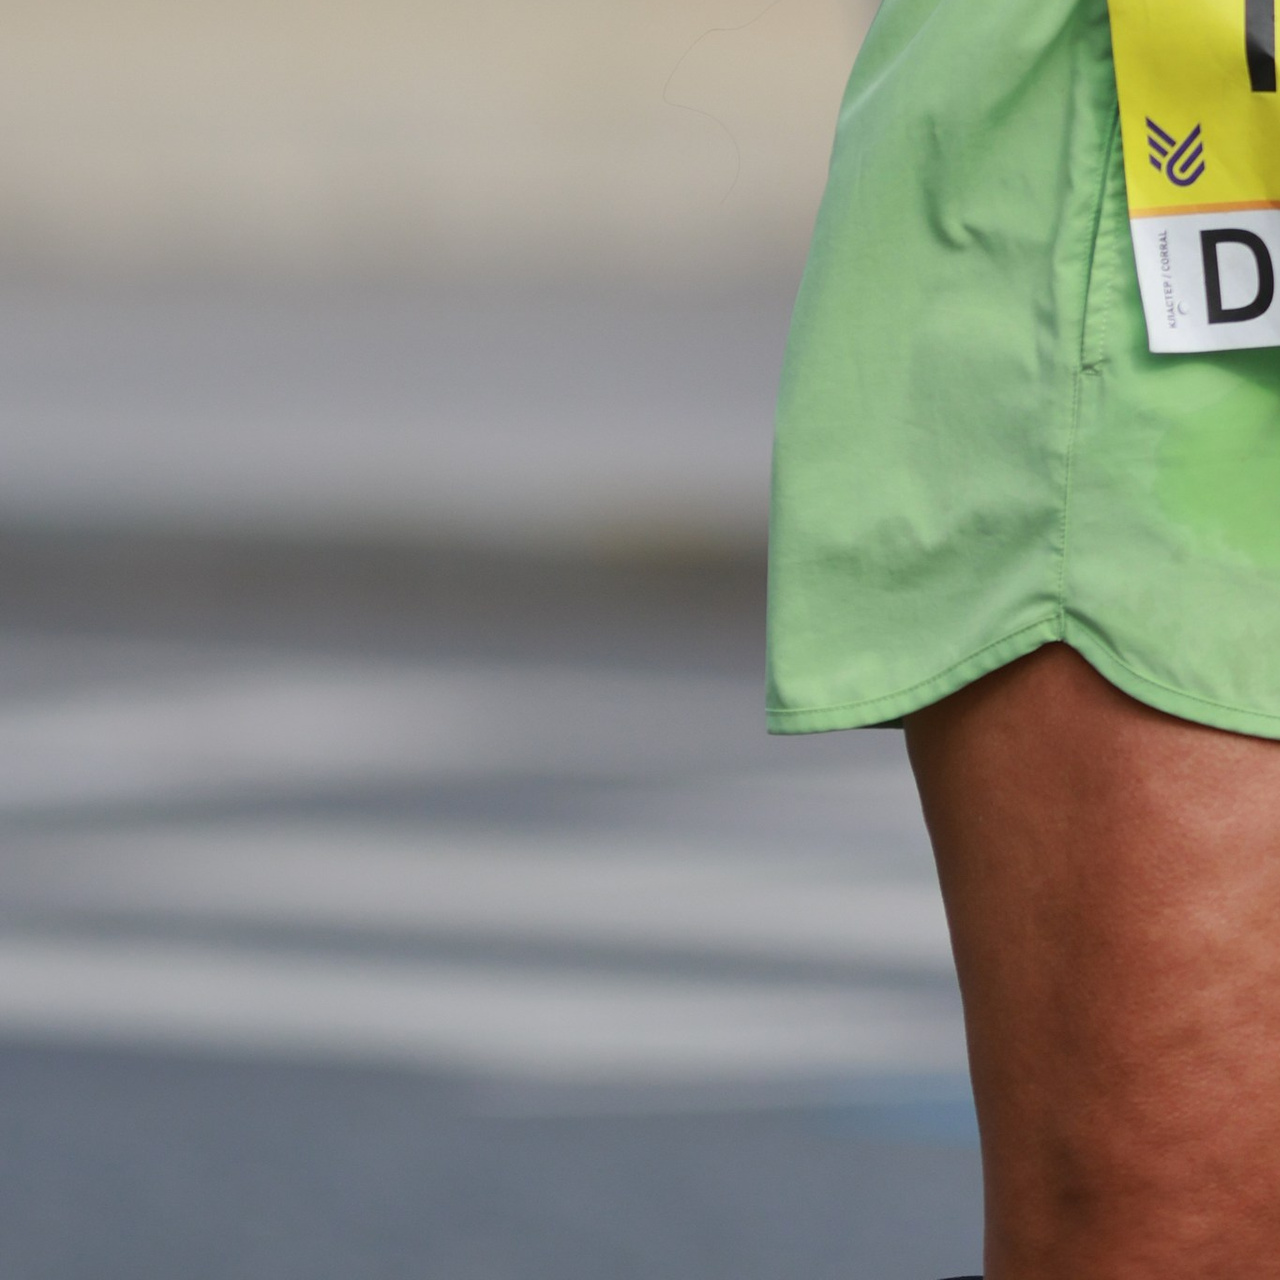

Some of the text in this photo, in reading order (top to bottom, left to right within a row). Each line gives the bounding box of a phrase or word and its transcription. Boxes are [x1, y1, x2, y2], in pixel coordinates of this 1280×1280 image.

[1158, 230, 1170, 272] CORRAL
[1199, 228, 1275, 325] D
[1162, 280, 1177, 329] КЛАСТЕР
